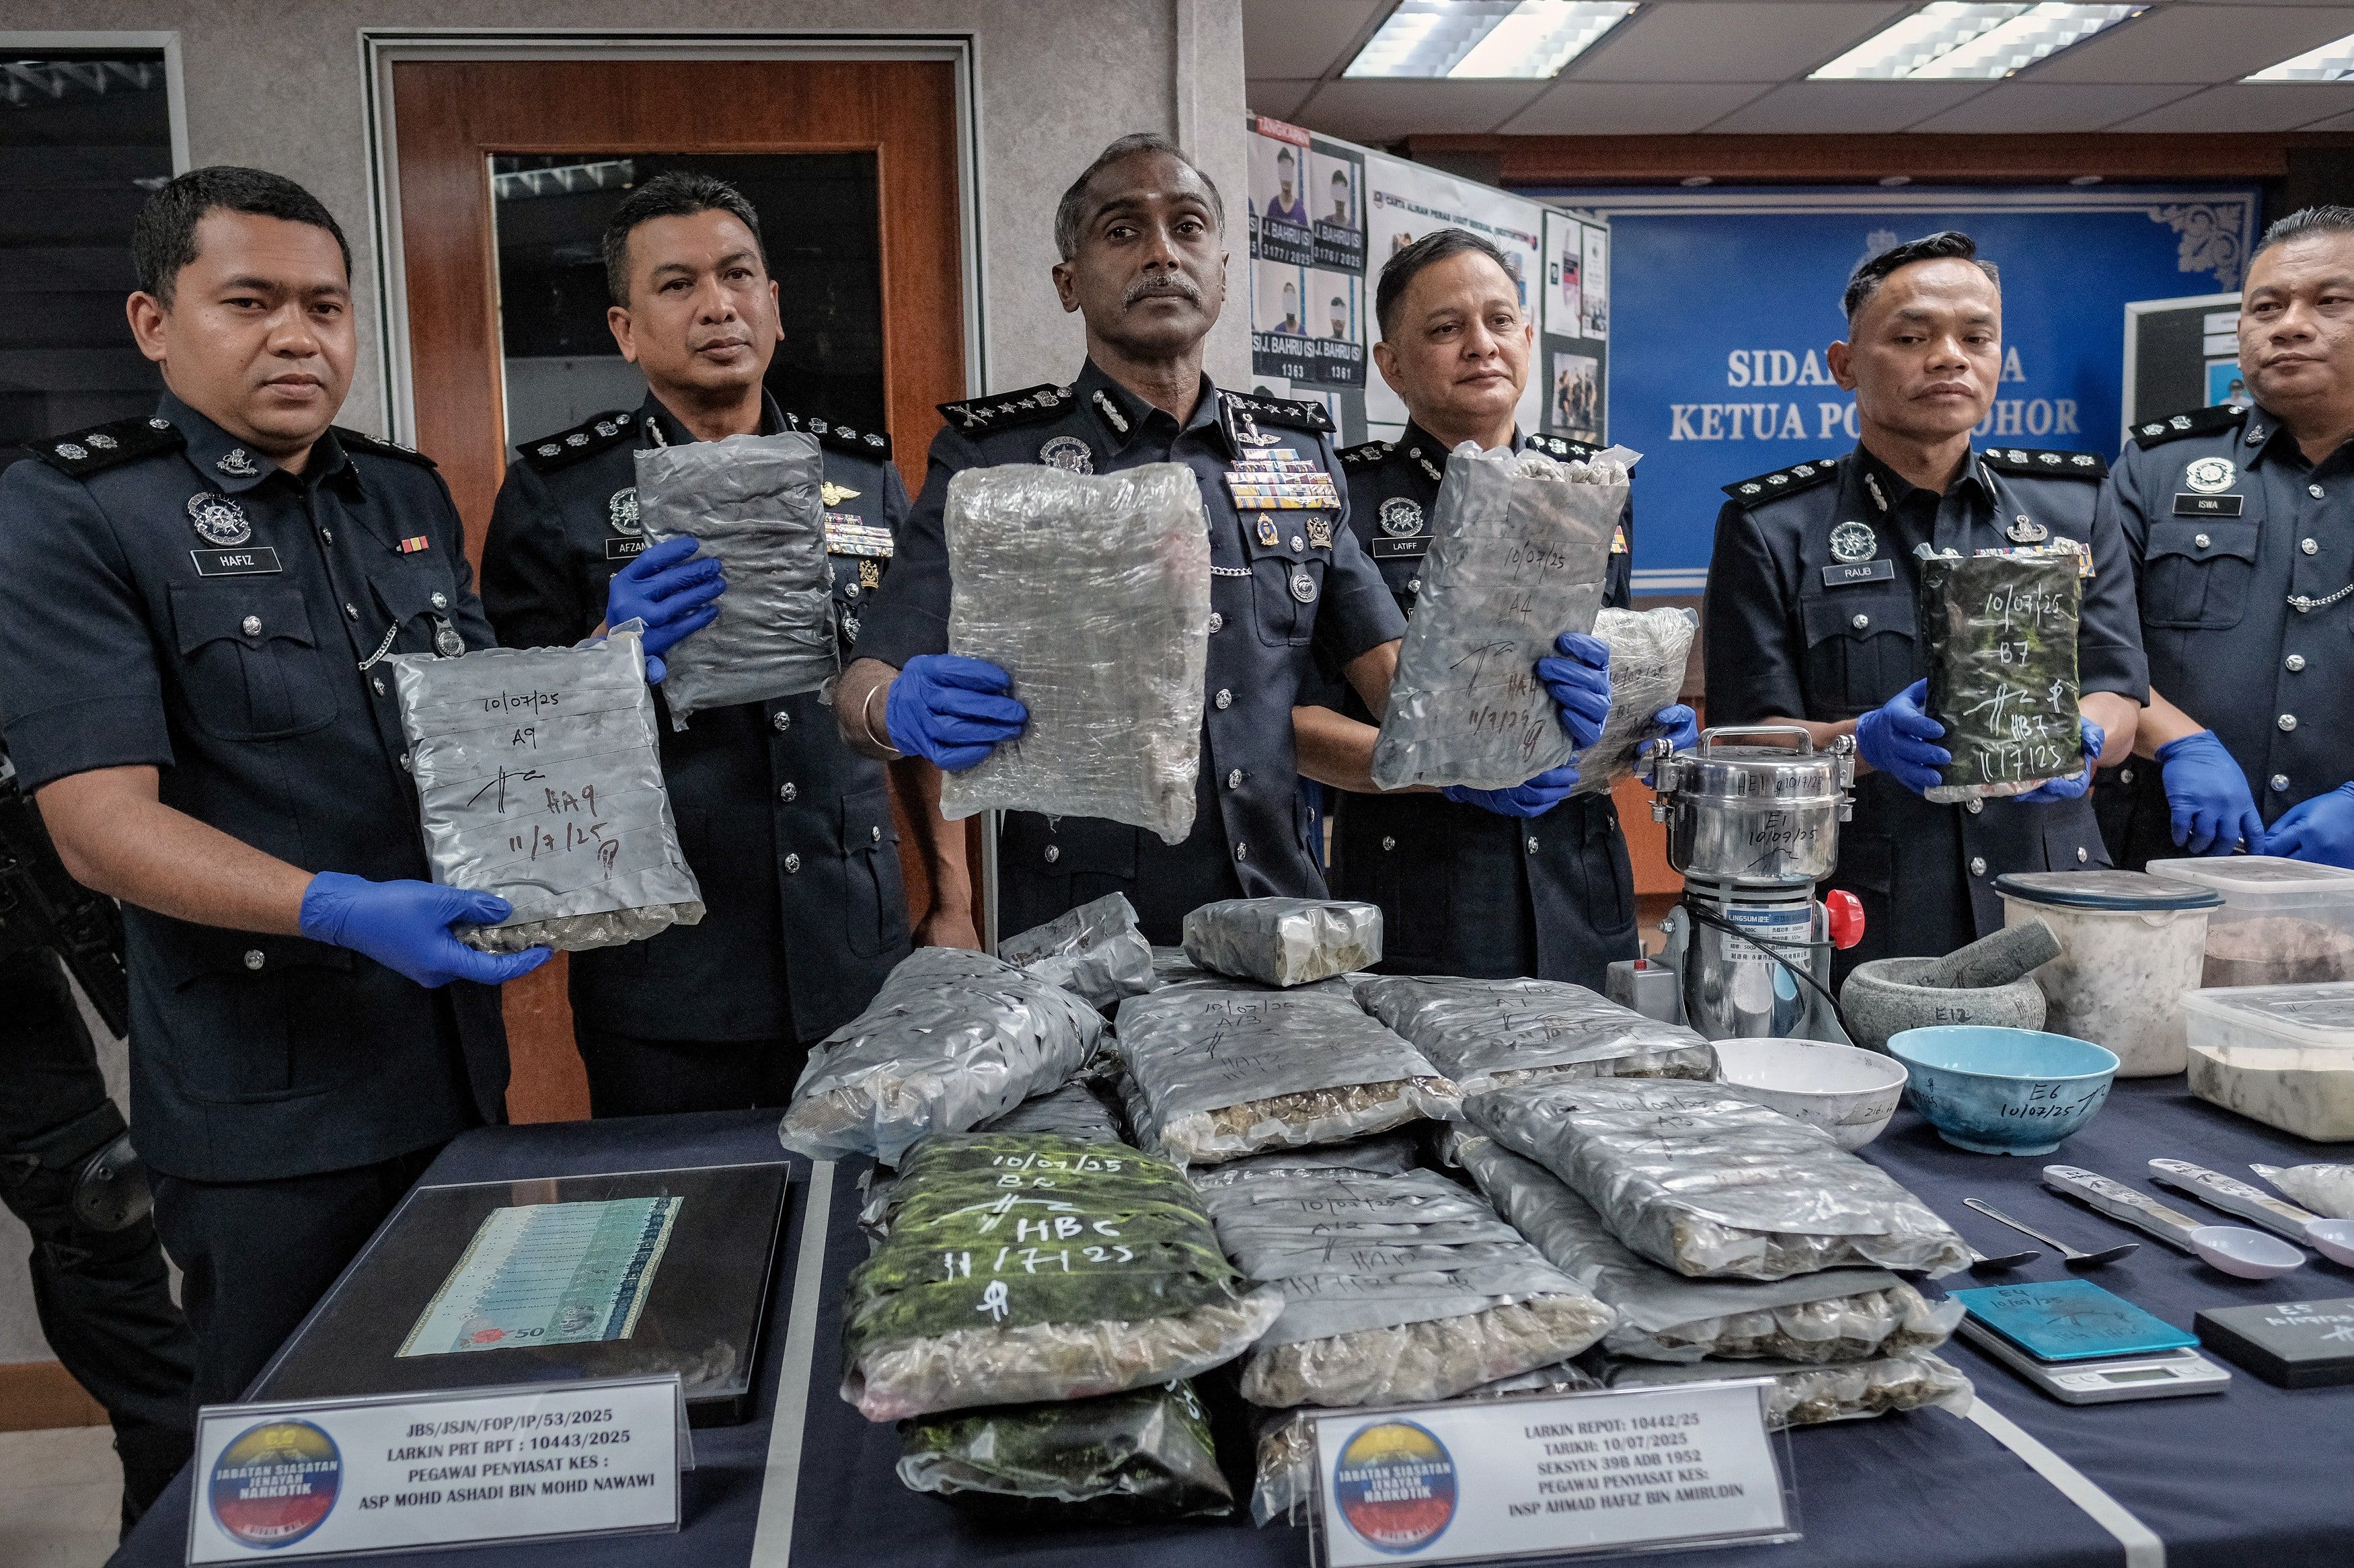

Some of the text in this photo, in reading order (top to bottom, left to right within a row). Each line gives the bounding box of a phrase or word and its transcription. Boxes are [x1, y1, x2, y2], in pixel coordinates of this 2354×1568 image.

[1271, 223, 1301, 244] BAHRU
[1322, 225, 1351, 246] BAHRU
[1272, 337, 1303, 356] BAHRU
[1324, 342, 1351, 360] BAHRU
[1282, 363, 1304, 379] 1363
[1331, 366, 1351, 380] 1361
[1669, 403, 1808, 441] KETUA
[1970, 399, 2081, 437] OHOR
[2198, 500, 2218, 509] ISWA
[1393, 542, 1417, 550] LATIFF
[219, 555, 255, 567] HAFIZ
[1844, 567, 1872, 578] RAUB
[1985, 582, 2063, 633] 10/07/25
[484, 690, 559, 714] 10/07/25
[512, 727, 538, 749] A9
[1729, 914, 1757, 923] LINGSUM
[1935, 1007, 1973, 1023] E12
[2030, 1083, 2061, 1101] E6
[2000, 1103, 2074, 1119] 10/07/25
[993, 1152, 1123, 1174] 10/07/25
[515, 1327, 545, 1339] 50
[1524, 1423, 1574, 1440] LARKIN
[1630, 1412, 1701, 1431] 10442/25
[387, 1429, 632, 1462] LARKIN PRT RPT 10443/2025
[1603, 1432, 1689, 1452] 10/07/2025
[217, 1460, 338, 1481] JABATAN SIASATAN
[408, 1455, 598, 1483] PEGAWAI PENYIASAT KES
[1537, 1449, 1703, 1477] SEKSYEN 39B ADB 1952
[239, 1483, 312, 1500] NARKOTIK
[358, 1473, 656, 1510] ASP MOHD ASHADI BIN MOHD NAWAWI
[1537, 1478, 1599, 1495] PEGAWAI
[1603, 1468, 1675, 1489] PENYIASAT
[1509, 1483, 1745, 1518] INSP AHMAD HAFIZ BIN AMIRUDIN
